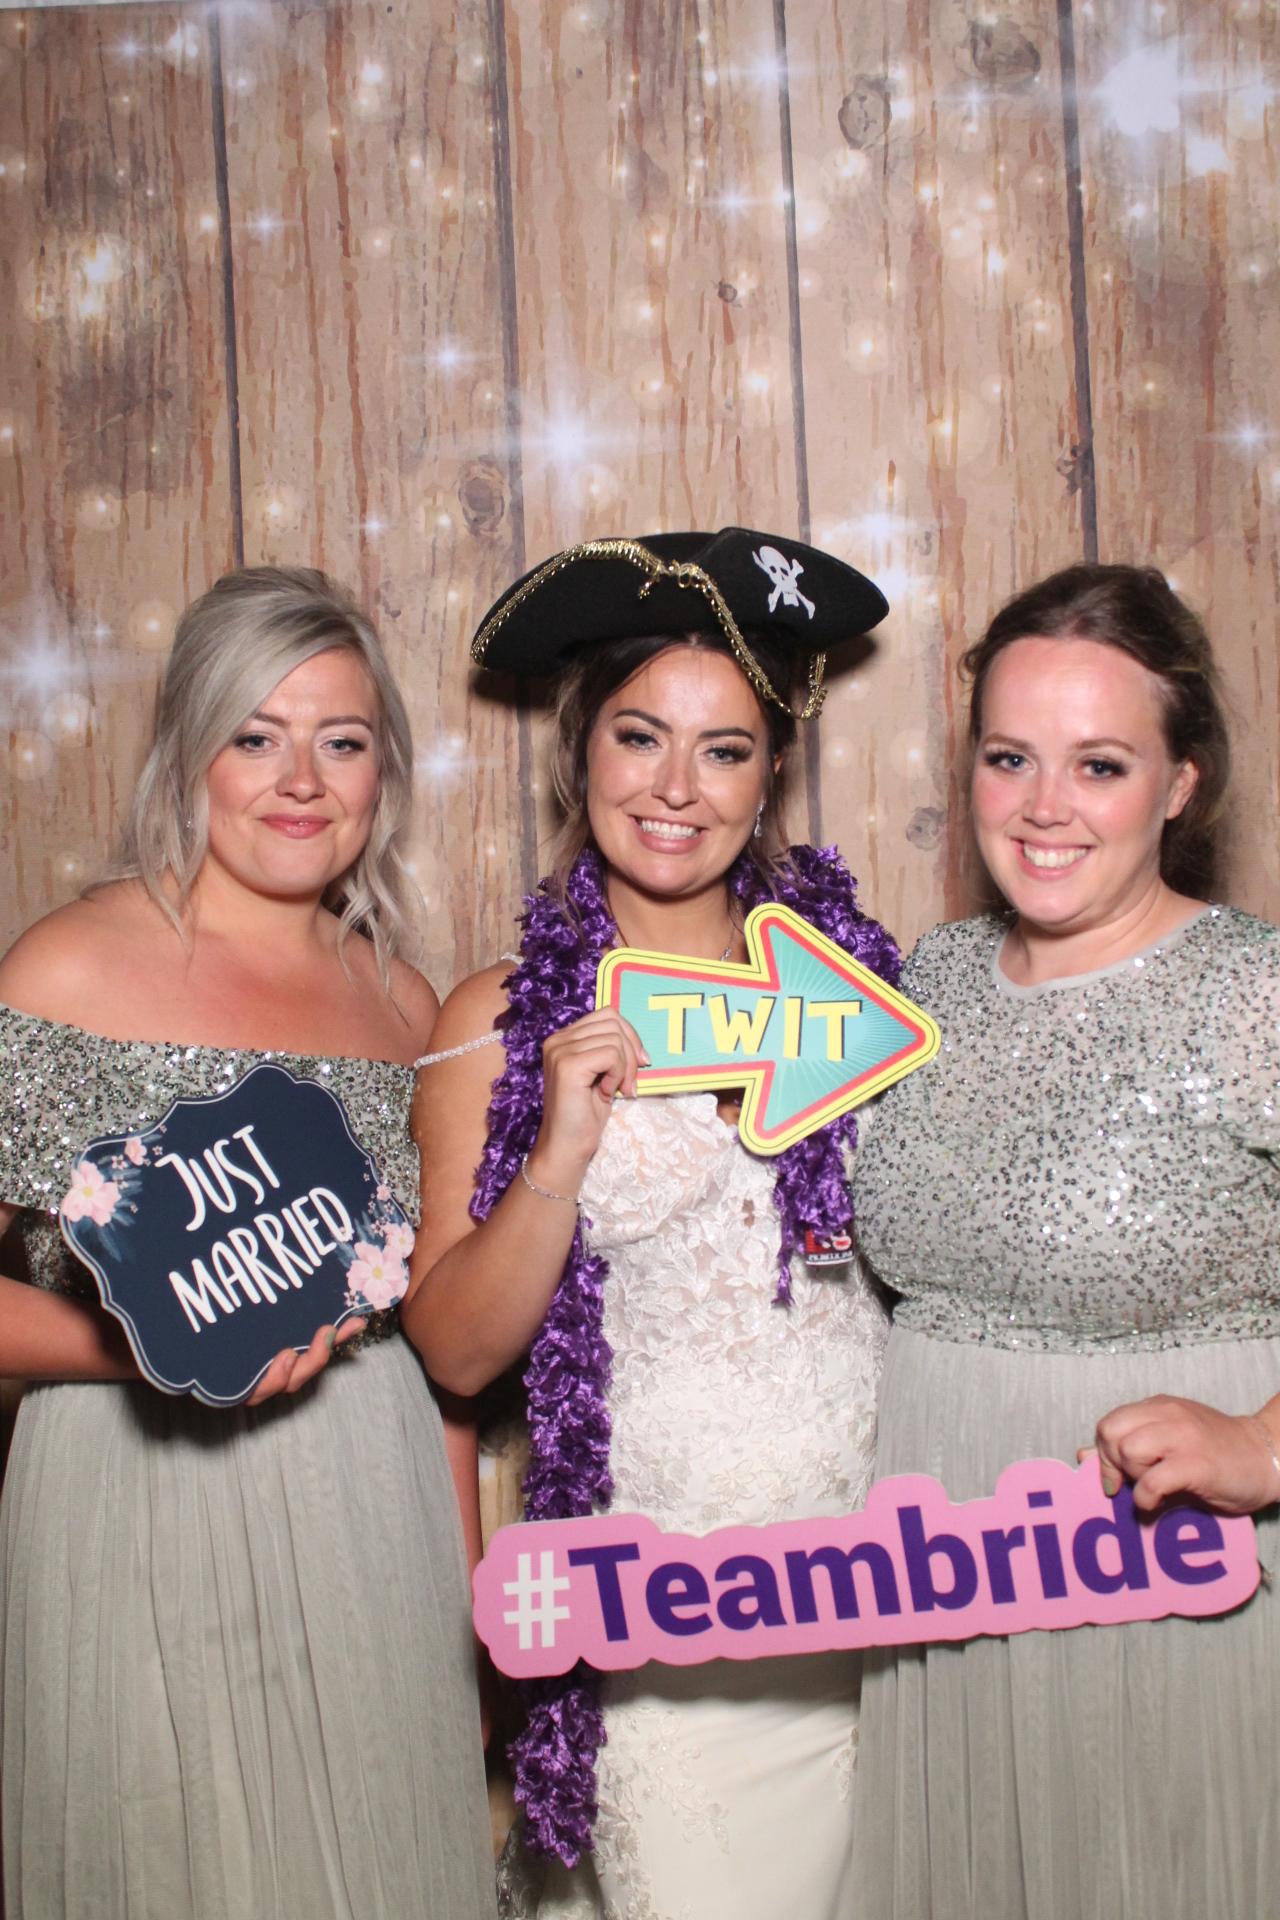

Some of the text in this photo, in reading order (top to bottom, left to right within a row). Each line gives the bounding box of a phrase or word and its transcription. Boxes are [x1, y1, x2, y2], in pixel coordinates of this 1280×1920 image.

[648, 993, 863, 1062] TWIT
[155, 1125, 281, 1231] JUST
[169, 1187, 354, 1333] MARRIED
[503, 1480, 1228, 1649] #Teambride
